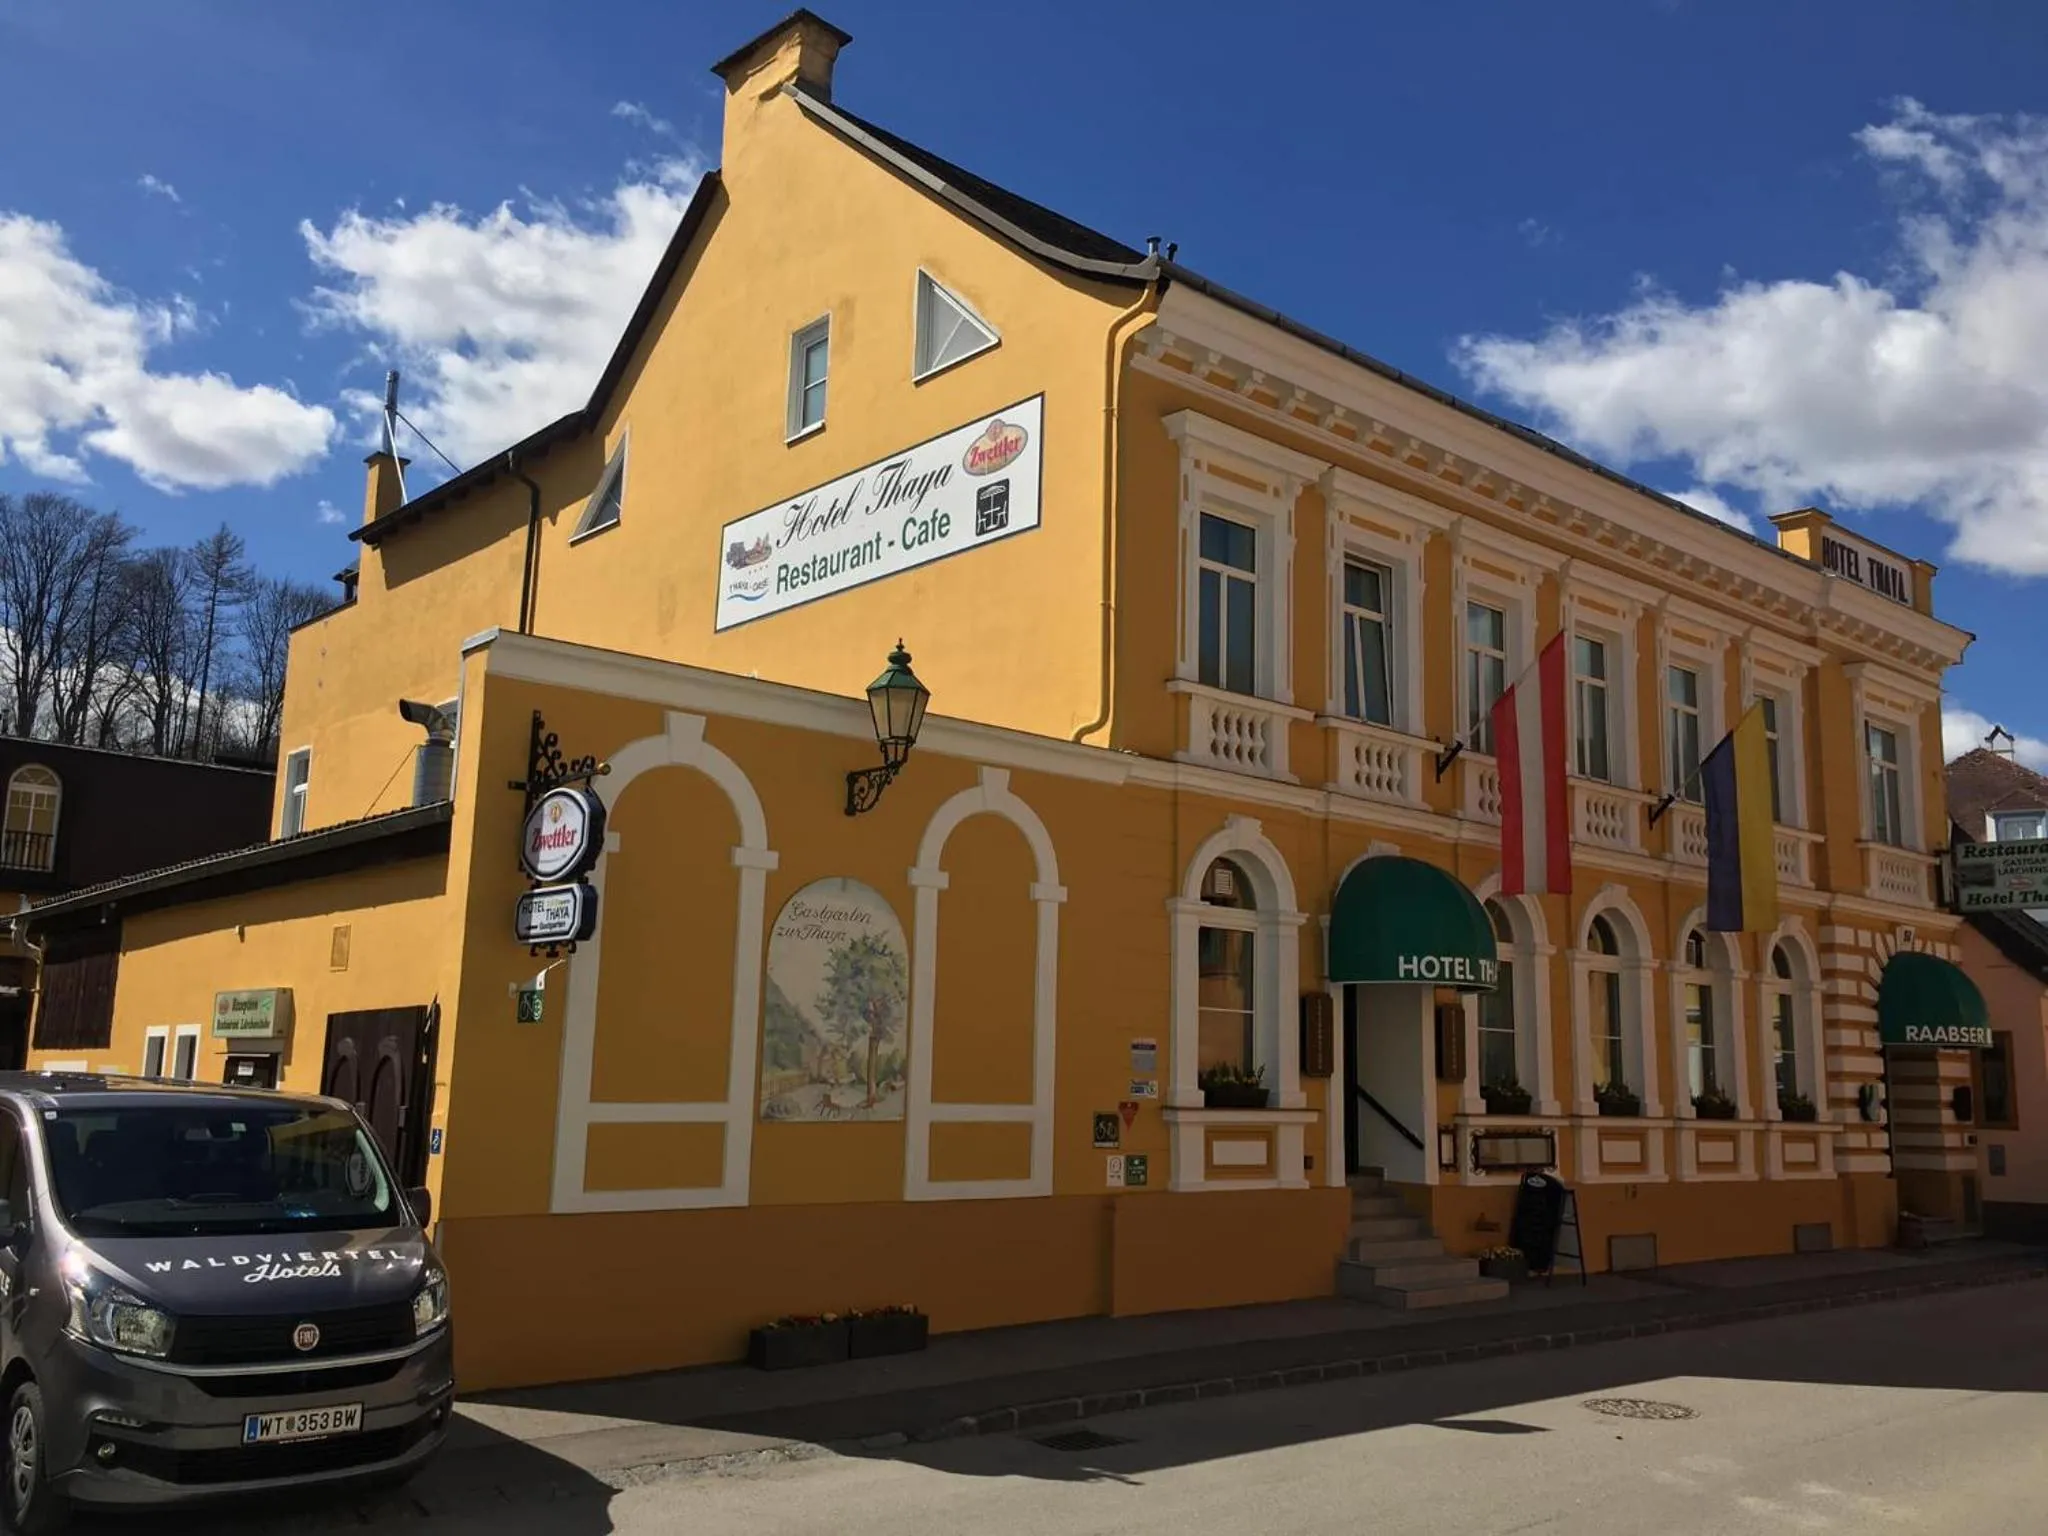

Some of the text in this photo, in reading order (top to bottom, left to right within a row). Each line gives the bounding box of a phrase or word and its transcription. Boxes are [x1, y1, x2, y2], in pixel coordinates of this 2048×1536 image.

[969, 435, 1022, 468] Zwettler
[776, 458, 954, 548] Hotel Thaya
[776, 532, 881, 595] Restaurant
[902, 507, 950, 551] Cafe
[1822, 536, 1908, 603] HOTEL THAYA
[531, 824, 577, 853] Zwettler
[1966, 889, 2014, 906] Hotel
[1399, 955, 1475, 980] HOTEL
[145, 1249, 406, 1273] WALDVIERTEL
[244, 1261, 342, 1283] Hotels
[260, 1417, 283, 1437] WT
[297, 1410, 330, 1433] 353
[333, 1408, 357, 1429] BW
